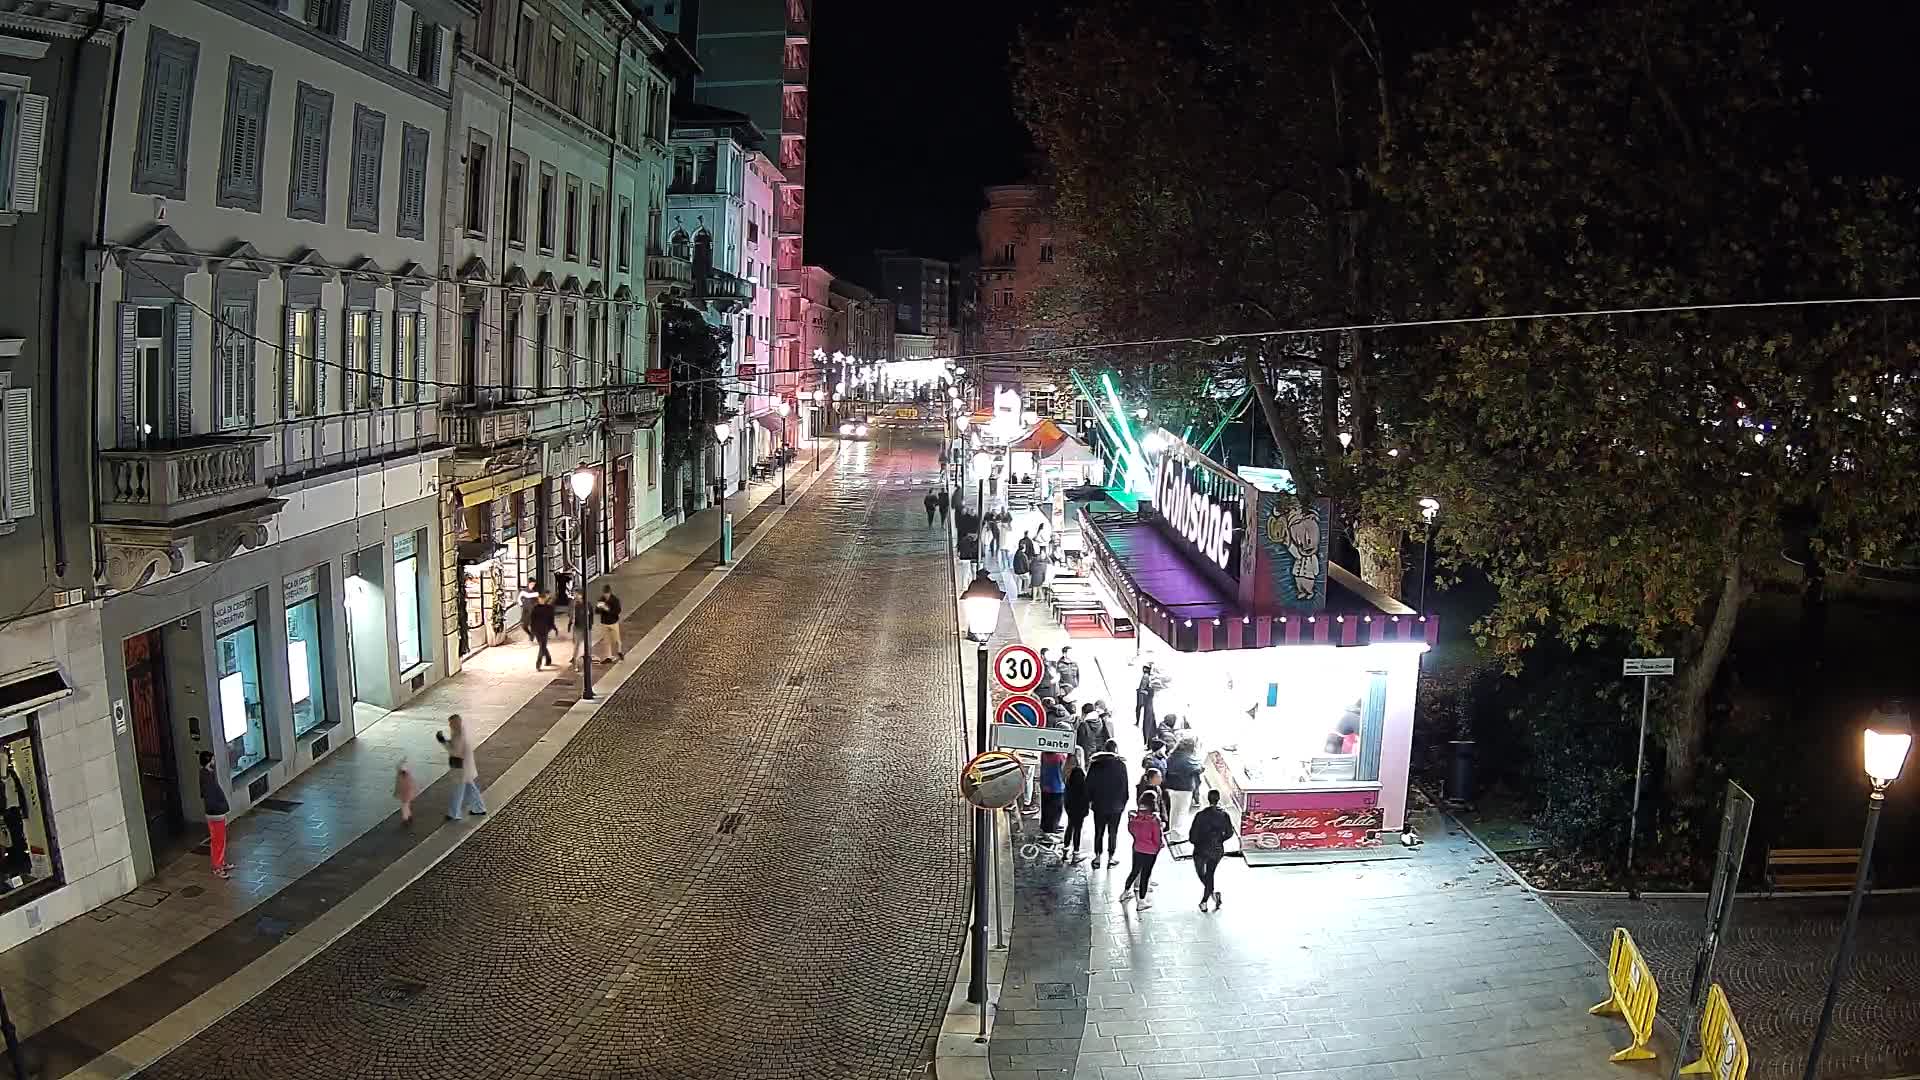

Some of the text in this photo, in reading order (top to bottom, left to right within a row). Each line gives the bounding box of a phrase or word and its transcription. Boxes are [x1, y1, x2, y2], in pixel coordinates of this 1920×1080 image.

[1161, 455, 1233, 570] Golosone
[1005, 657, 1033, 680] 30
[1037, 737, 1070, 749] Dante
